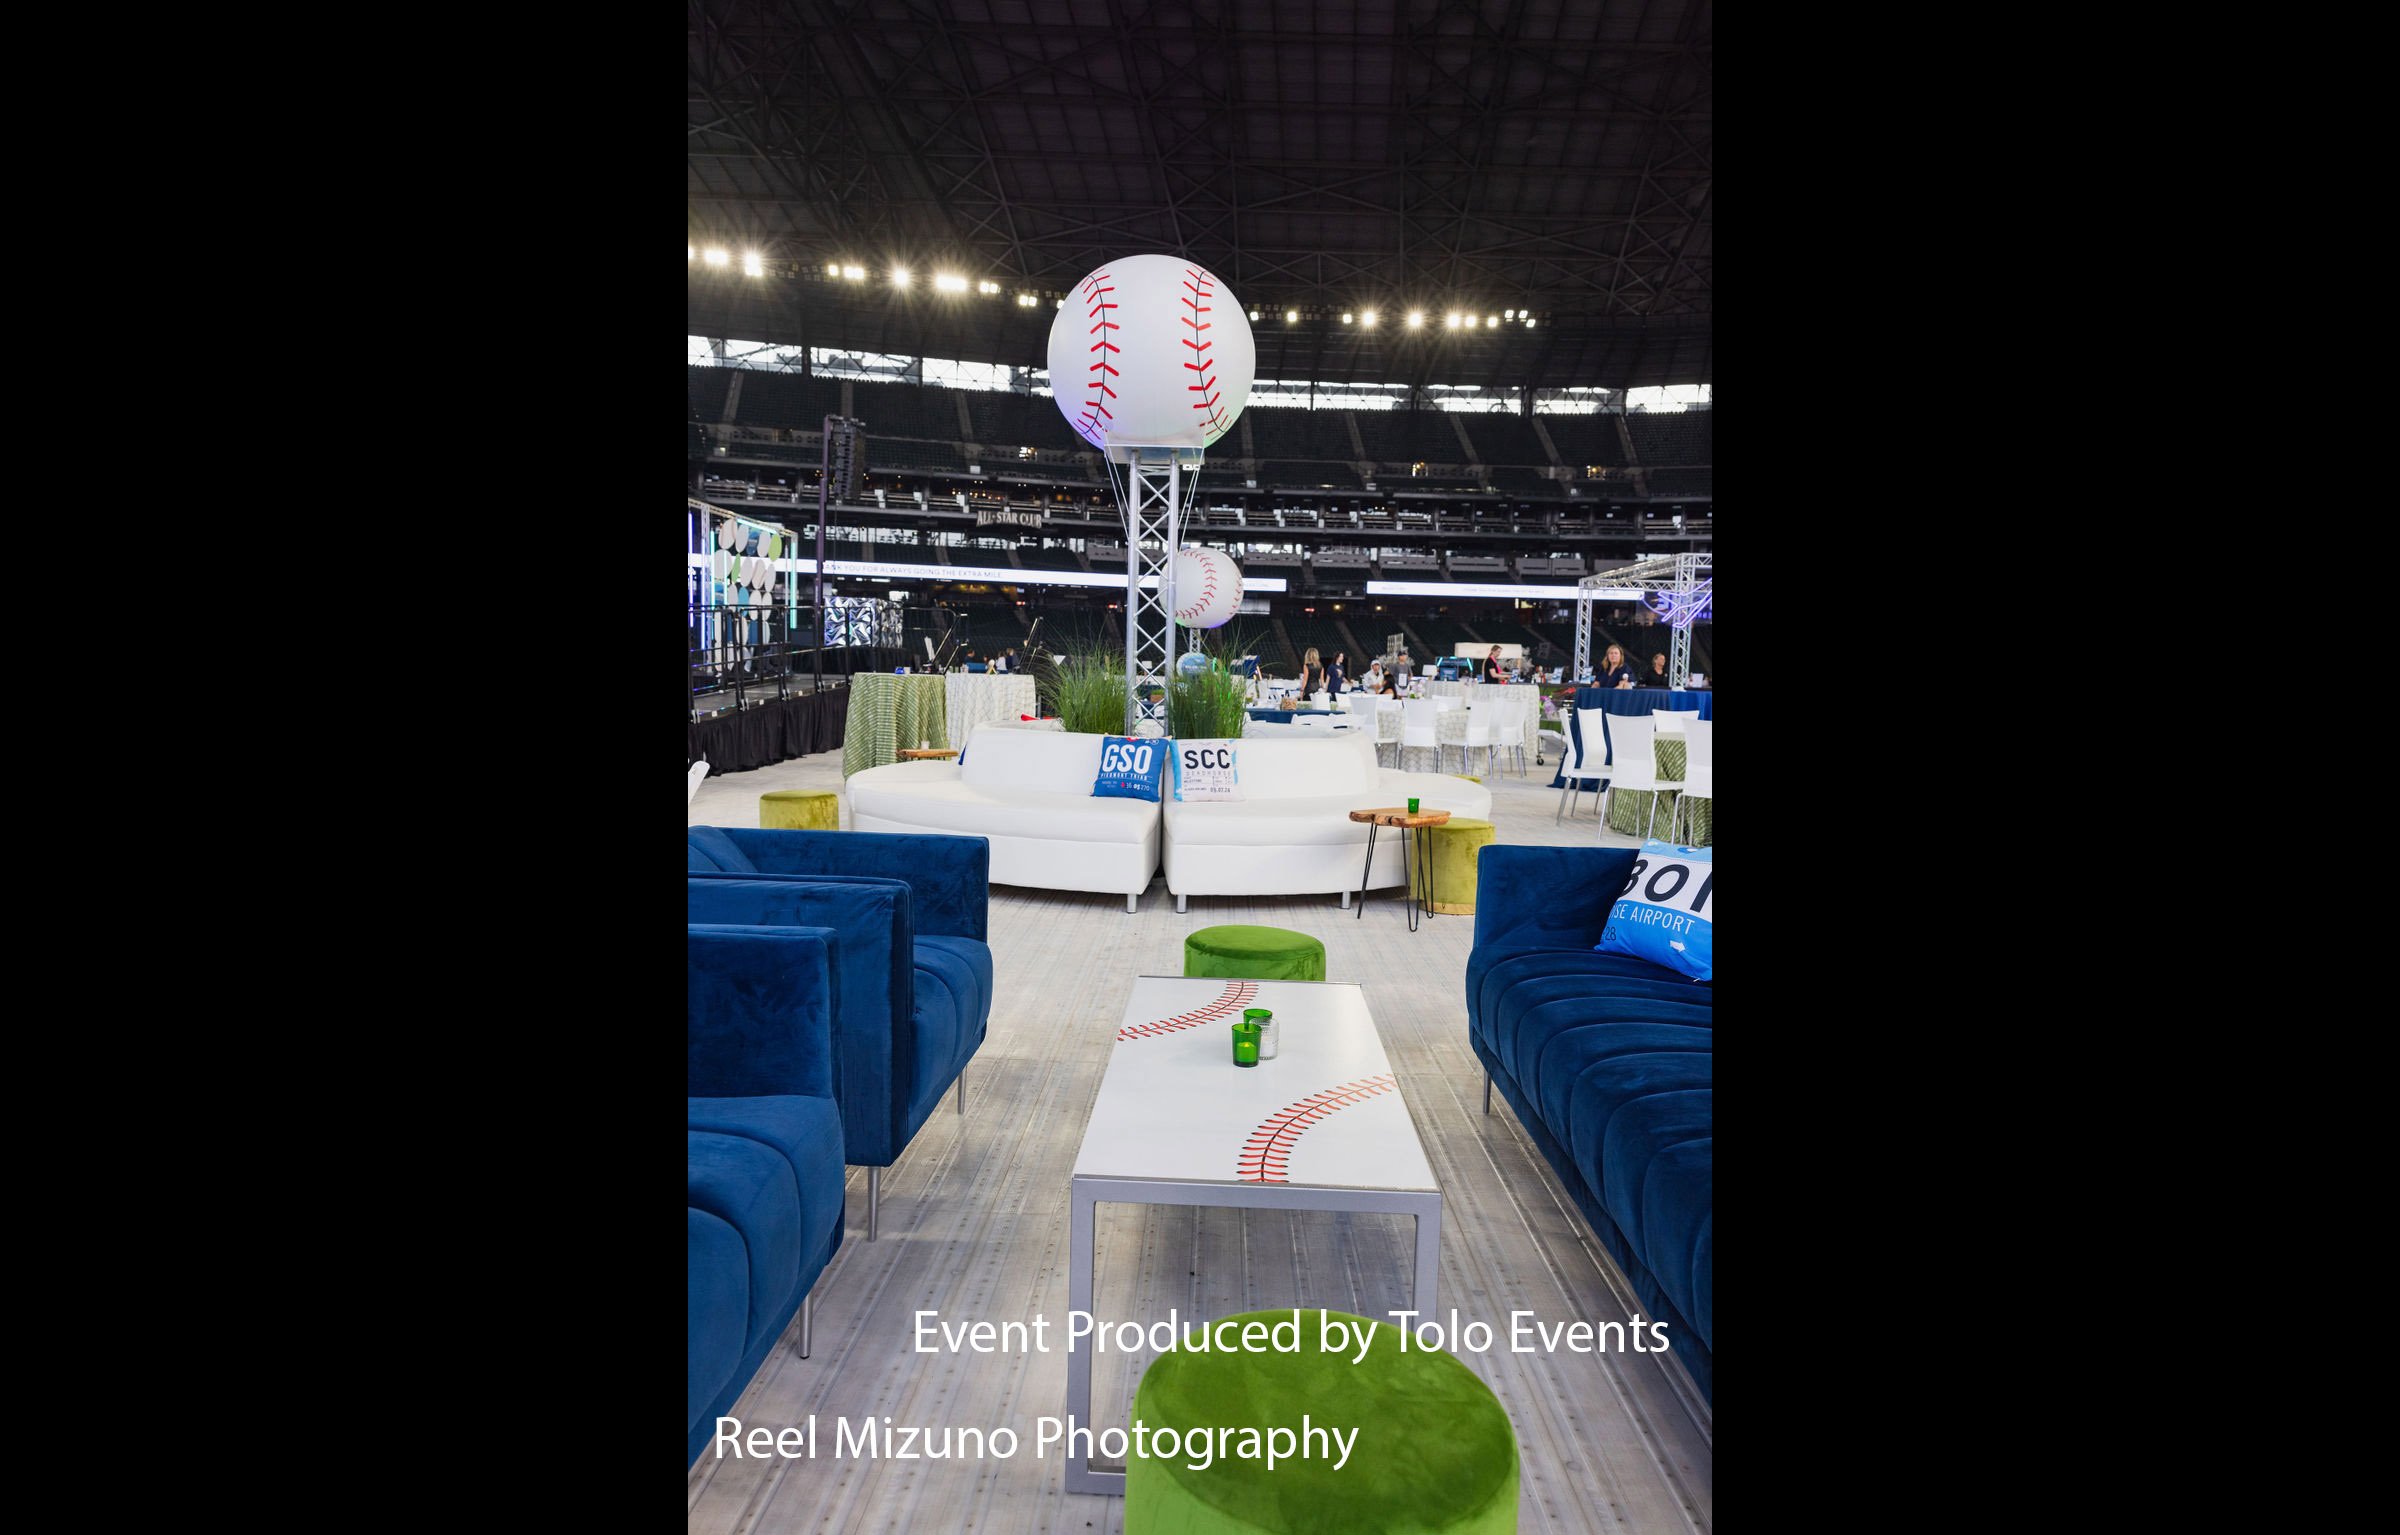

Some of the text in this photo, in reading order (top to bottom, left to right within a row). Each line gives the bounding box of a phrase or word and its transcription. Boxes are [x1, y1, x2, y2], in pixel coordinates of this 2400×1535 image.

[1020, 513, 1042, 529] CLUB
[880, 566, 912, 574] ALWAYS
[1102, 744, 1153, 774] GSO
[1184, 749, 1230, 769] SCC
[1630, 906, 1695, 935] AIRPORT
